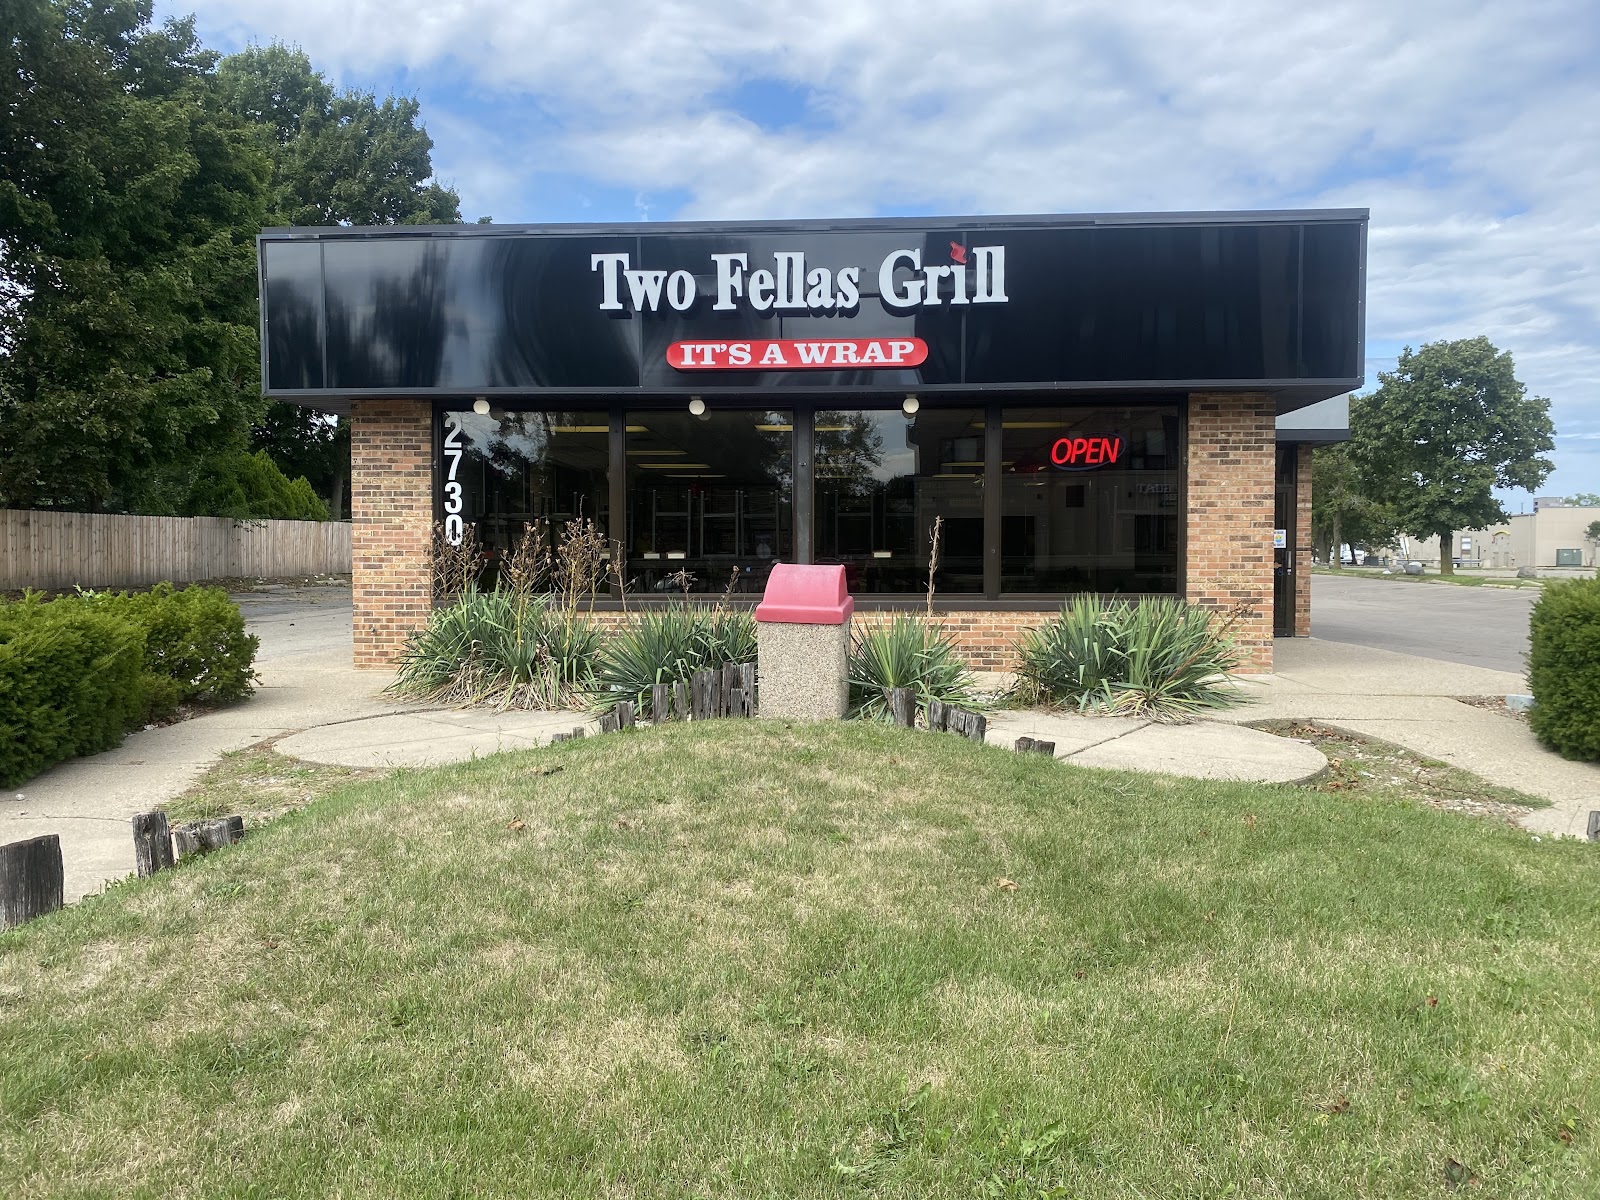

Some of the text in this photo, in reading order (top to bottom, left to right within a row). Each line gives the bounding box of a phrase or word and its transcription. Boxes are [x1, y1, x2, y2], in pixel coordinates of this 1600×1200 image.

[591, 244, 1009, 311] Two Fellas Grill
[680, 340, 915, 366] IT'S A WRAP
[1051, 438, 1119, 464] OPEN
[444, 417, 463, 546] 2730
